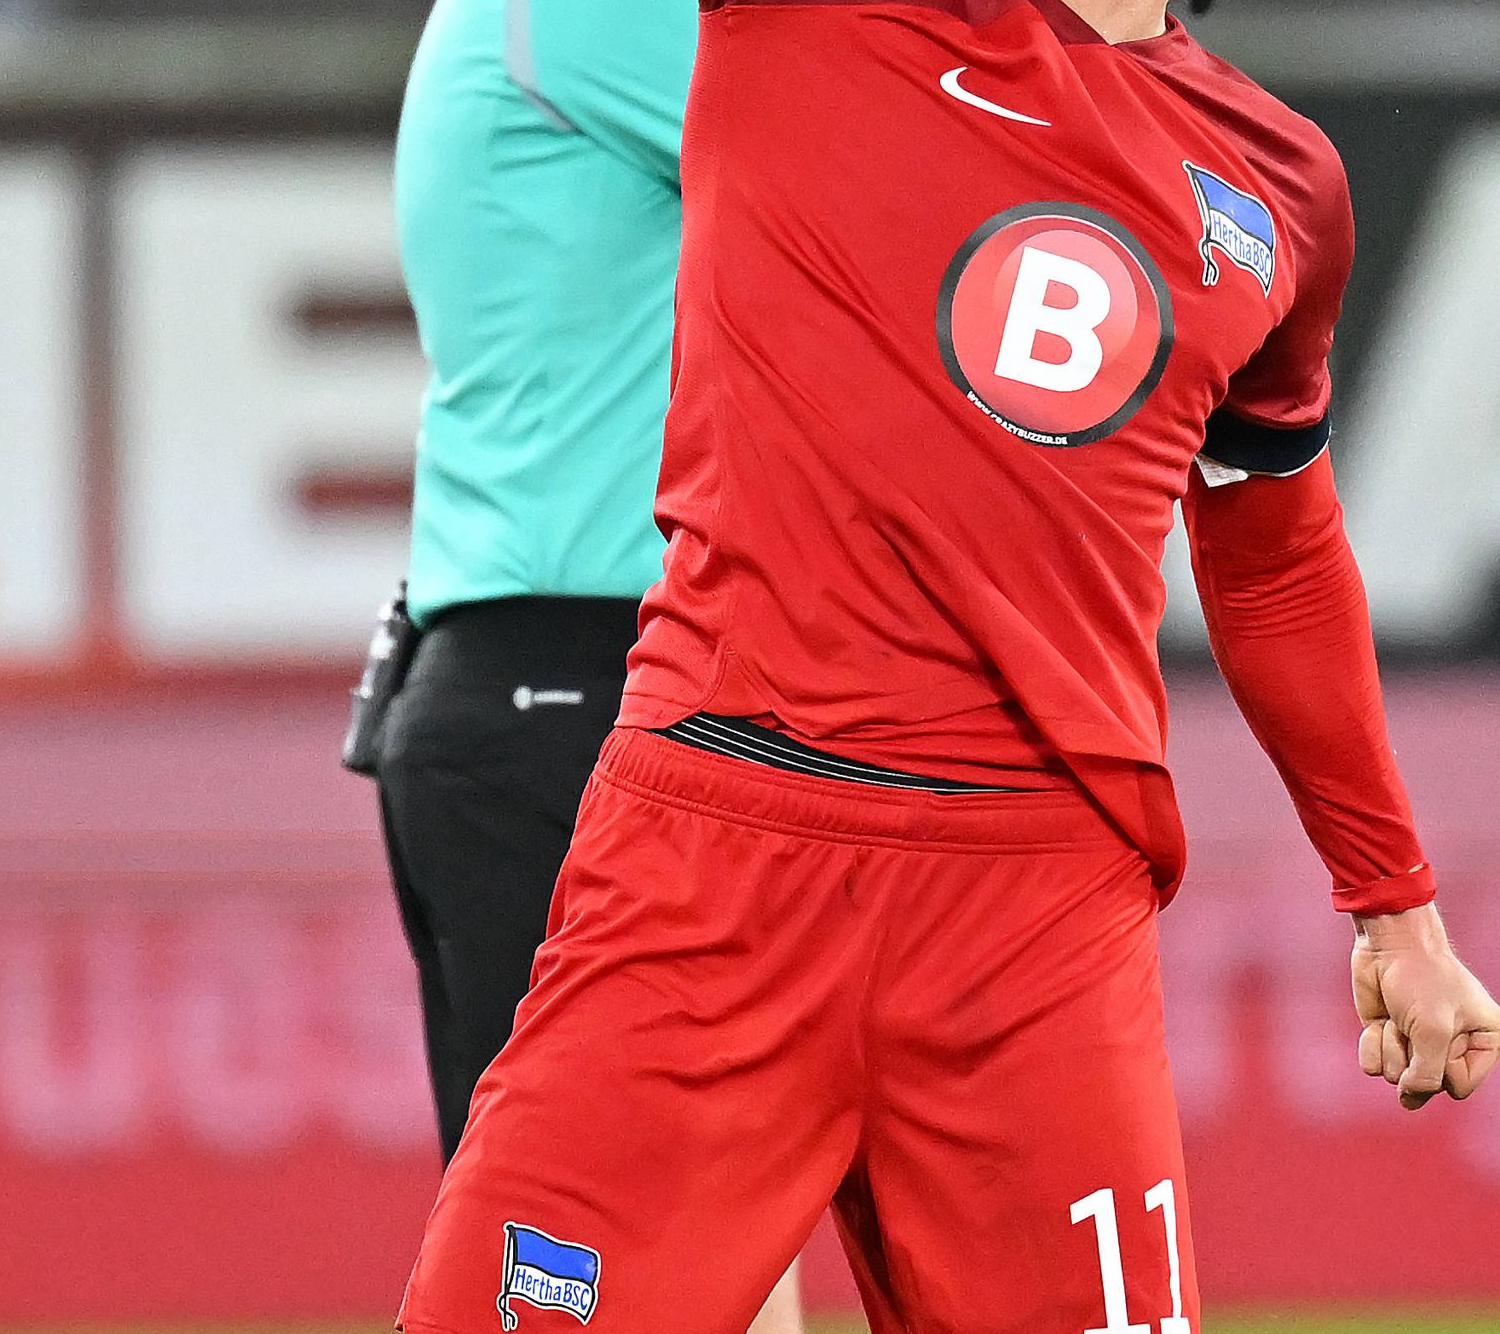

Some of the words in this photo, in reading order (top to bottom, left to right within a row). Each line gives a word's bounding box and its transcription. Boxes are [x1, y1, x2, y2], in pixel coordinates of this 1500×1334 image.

[994, 245, 1111, 392] B
[514, 1267, 562, 1302] Hertha
[562, 1282, 590, 1311] BSC
